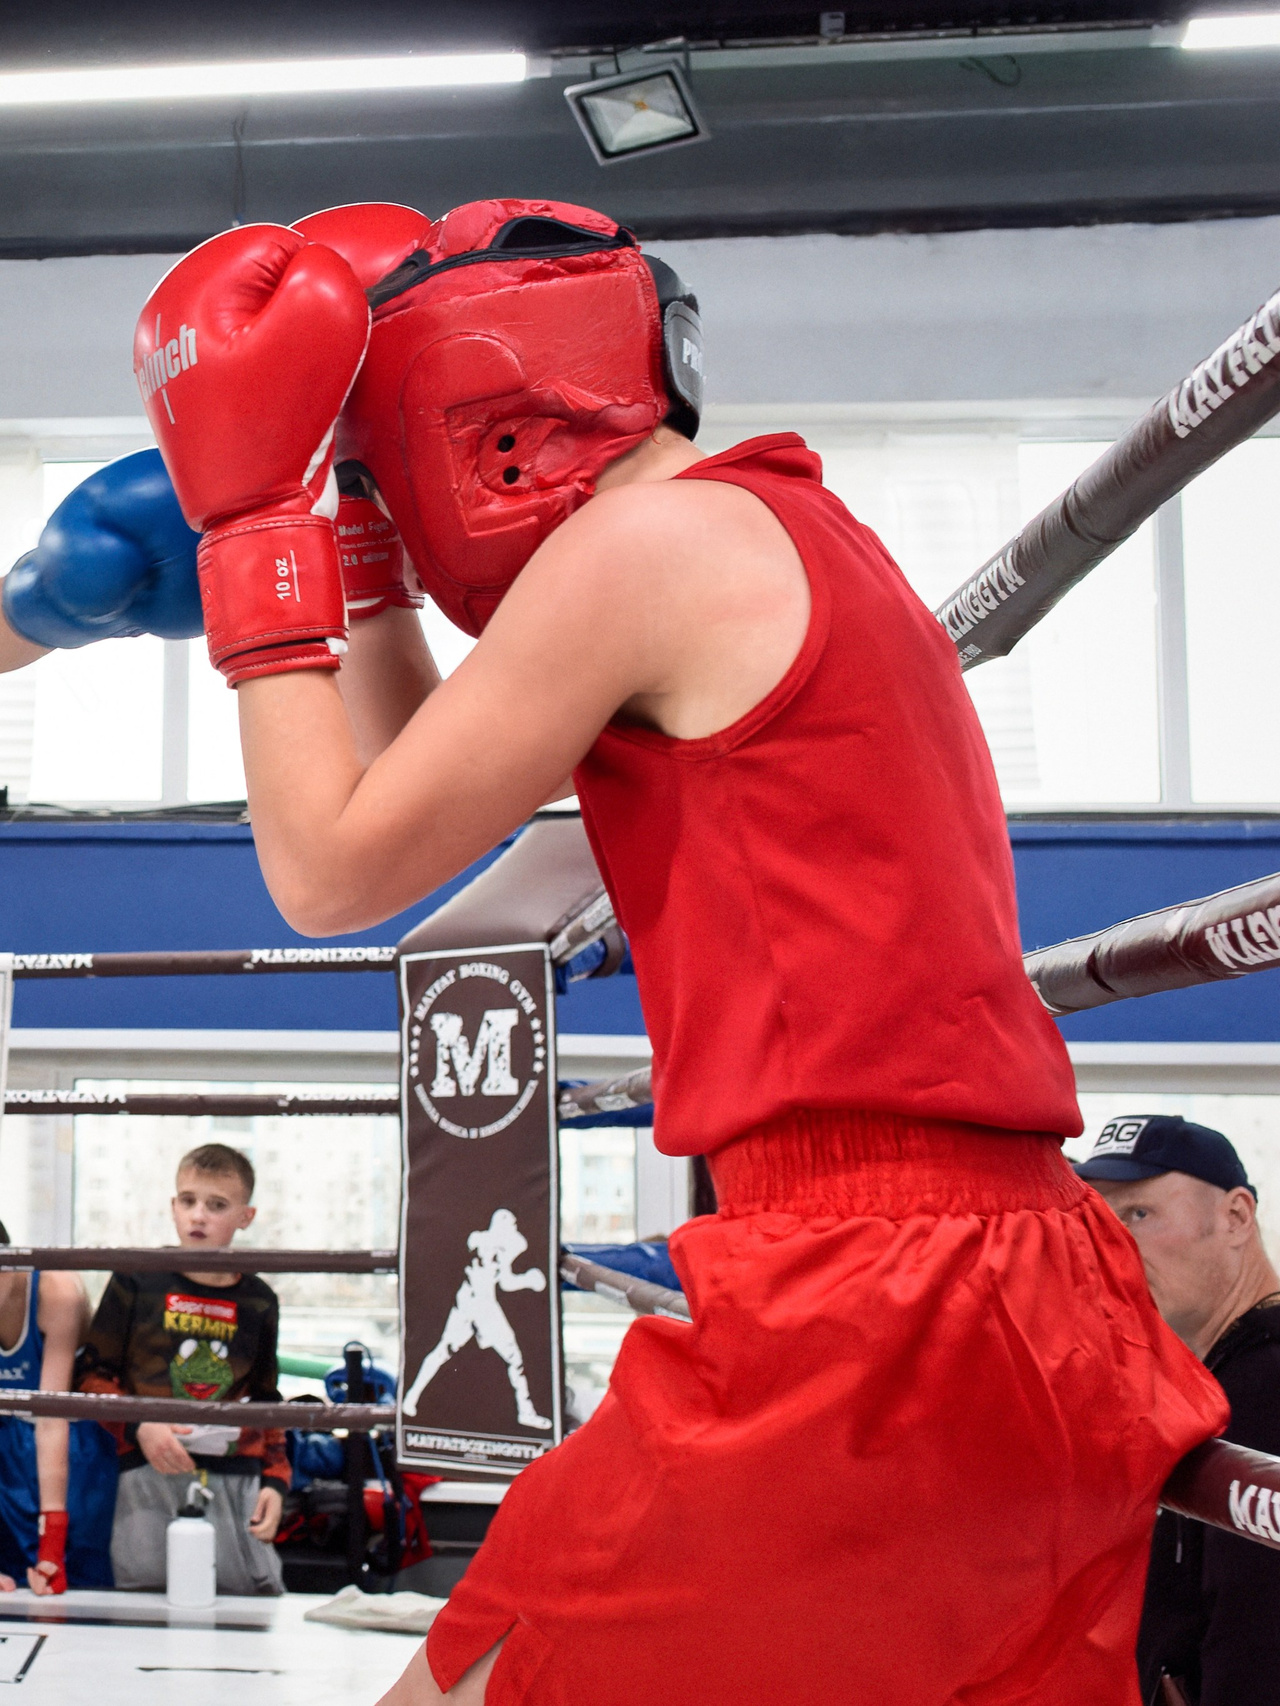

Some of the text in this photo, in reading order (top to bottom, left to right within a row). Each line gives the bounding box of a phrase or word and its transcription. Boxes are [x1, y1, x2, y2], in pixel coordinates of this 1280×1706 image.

[275, 581, 291, 600] 10
[458, 962, 510, 985] BOXING
[429, 1008, 519, 1098] M
[1094, 1123, 1142, 1148] BG
[163, 1310, 238, 1342] KERMIT
